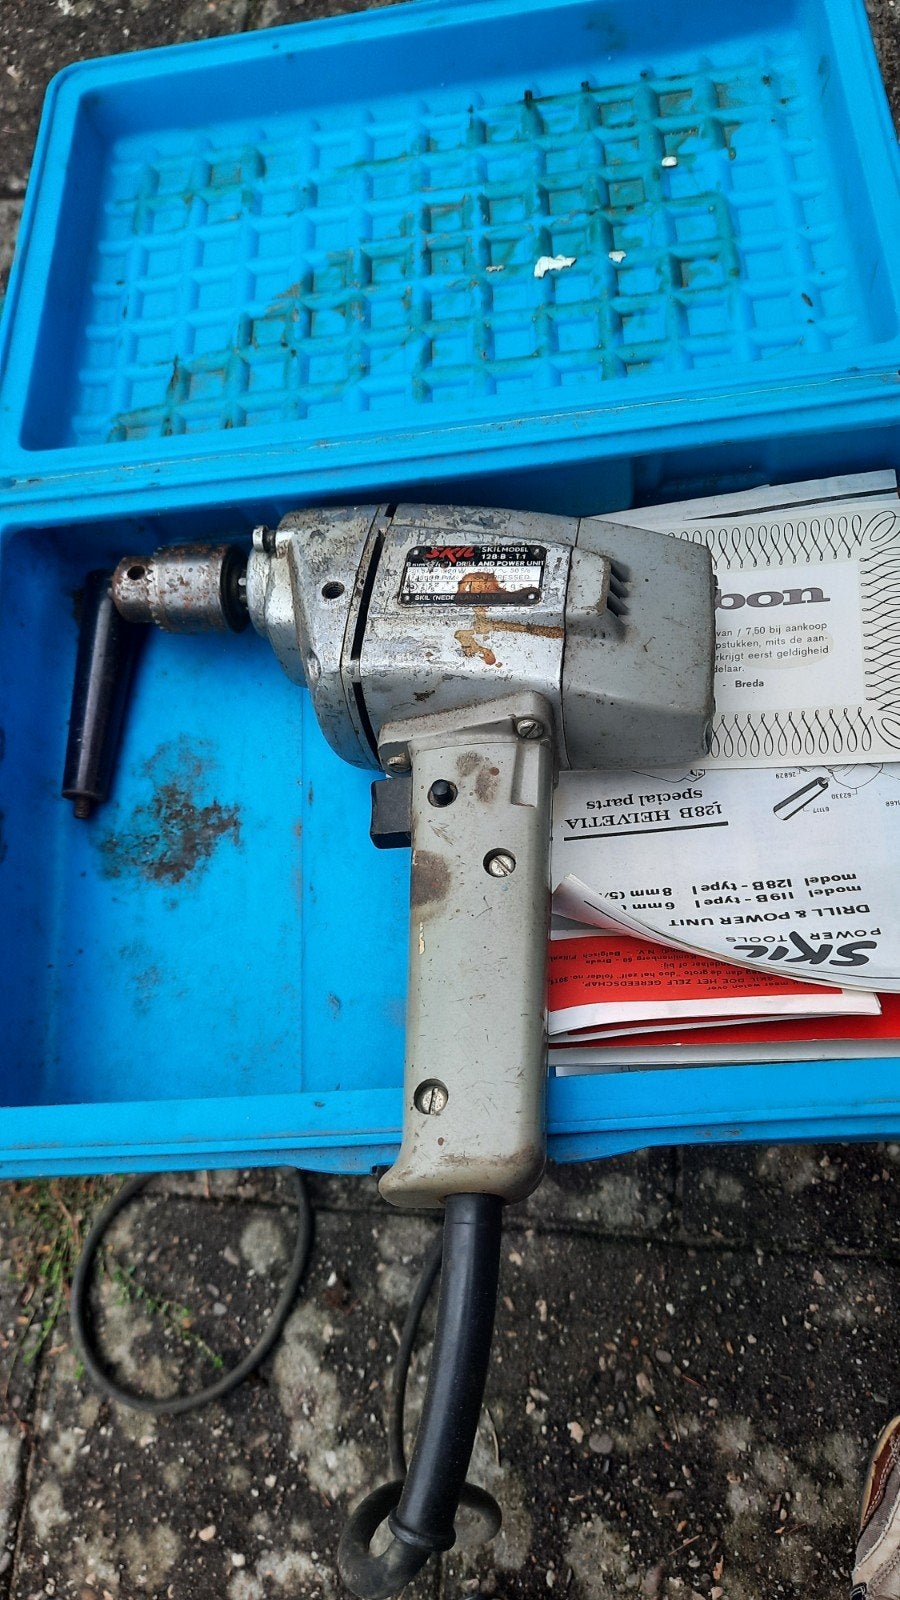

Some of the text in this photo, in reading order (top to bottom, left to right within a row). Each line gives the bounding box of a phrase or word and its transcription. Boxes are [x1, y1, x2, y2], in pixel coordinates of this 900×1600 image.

[425, 547, 475, 563] SKIL
[745, 626, 766, 636] 7,50
[769, 625, 781, 635] bij
[785, 622, 828, 633] aankoop
[765, 637, 786, 646] mits
[790, 635, 803, 644] de
[806, 634, 828, 643] aan-
[748, 650, 773, 660] eerst
[776, 645, 830, 659] geldigheid
[734, 679, 765, 688] Breda
[586, 788, 703, 811] special parts
[564, 804, 722, 830] 128B HELVETIA
[804, 874, 857, 887] model
[808, 884, 861, 898] model
[668, 904, 871, 927] DRILL & POWER UNIT
[725, 928, 882, 944] POWER TOOLS
[733, 931, 878, 967] SKIL
